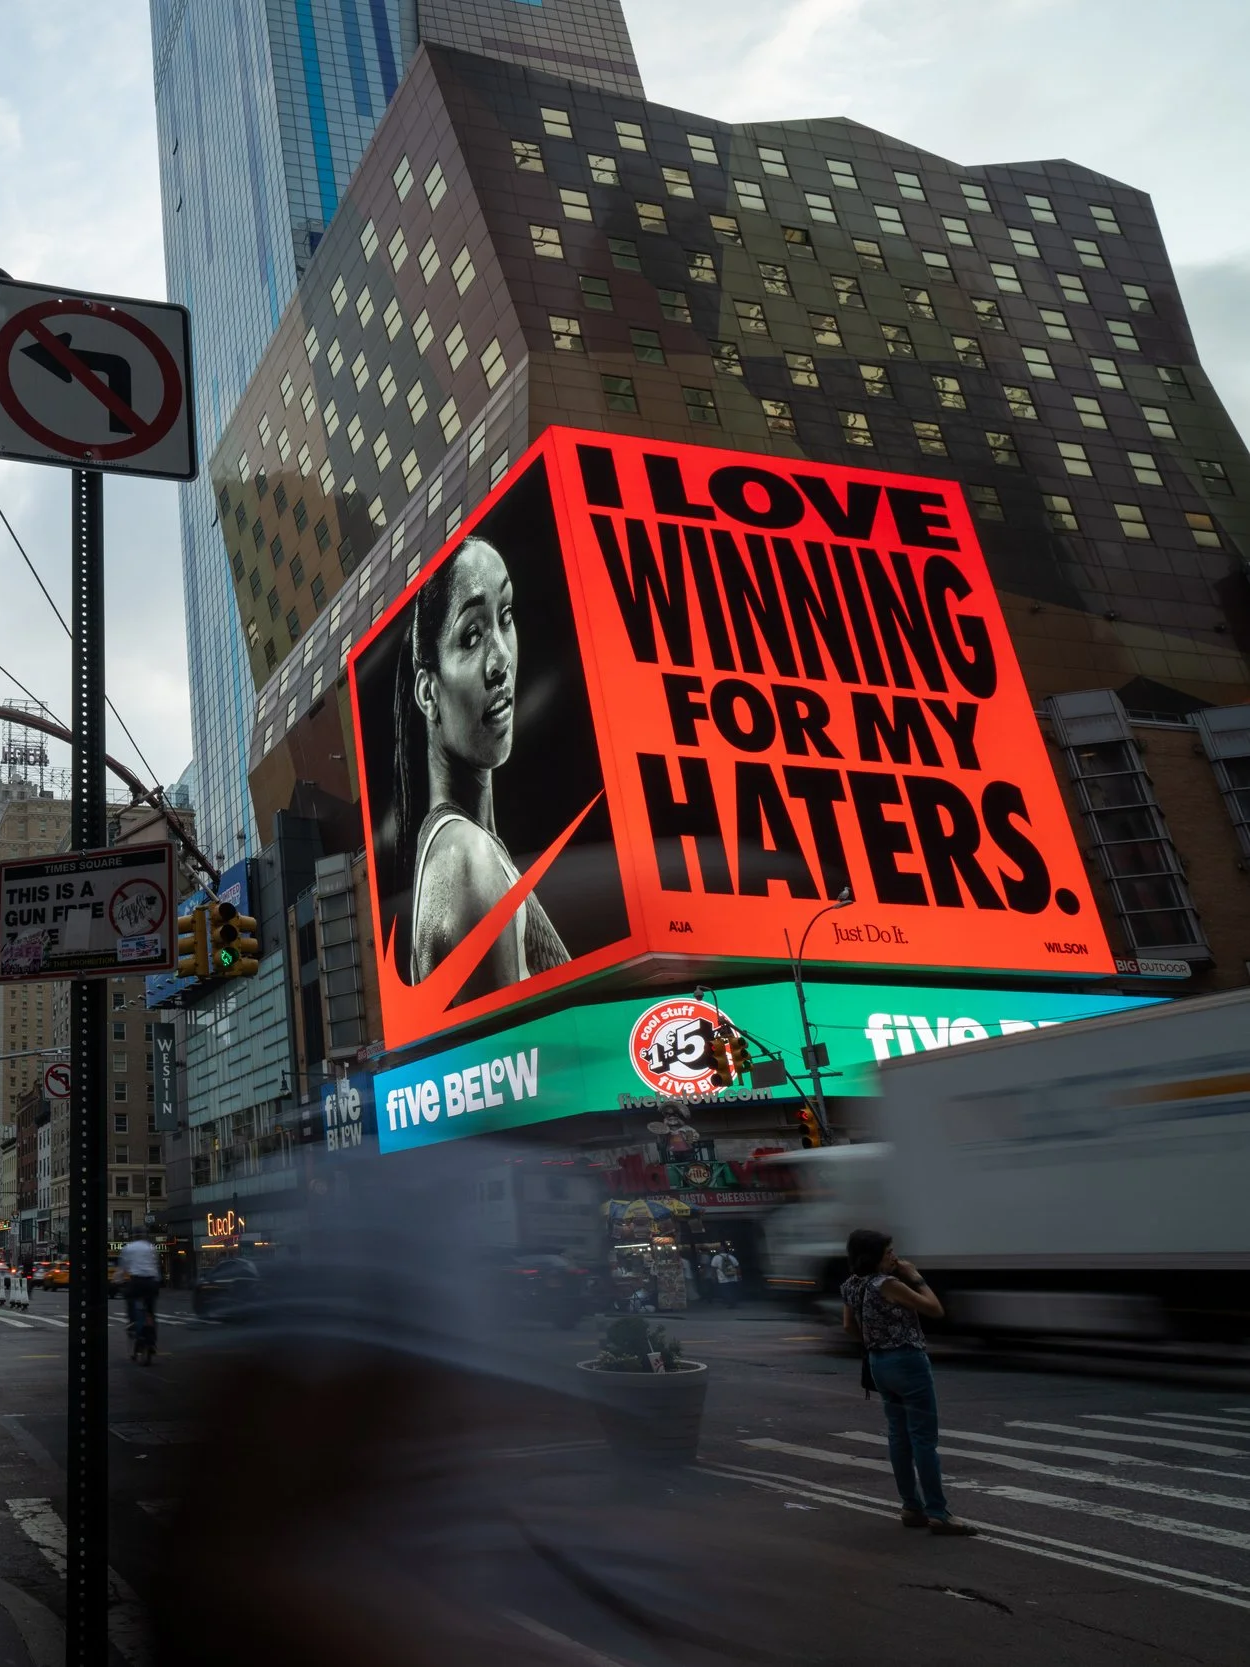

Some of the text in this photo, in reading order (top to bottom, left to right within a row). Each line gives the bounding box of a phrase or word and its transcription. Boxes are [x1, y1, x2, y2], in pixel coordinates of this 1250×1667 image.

[576, 443, 962, 553] I LOVE
[589, 512, 997, 700] WINNING
[661, 671, 982, 771] FOR MY
[636, 752, 1080, 916] HATERS.
[45, 857, 123, 874] TIMES SQUARE
[6, 881, 94, 905] THIS IS A
[5, 907, 46, 927] GUN
[832, 922, 910, 944] Just Do It.
[1044, 941, 1089, 955] WILSON
[1116, 960, 1187, 973] BIG OUTDOOR
[640, 1005, 696, 1040] cool stuff
[157, 1039, 172, 1114] WESTIN
[658, 1075, 696, 1095] five
[386, 1048, 538, 1130] five BELOW
[680, 1193, 707, 1203] PASTA
